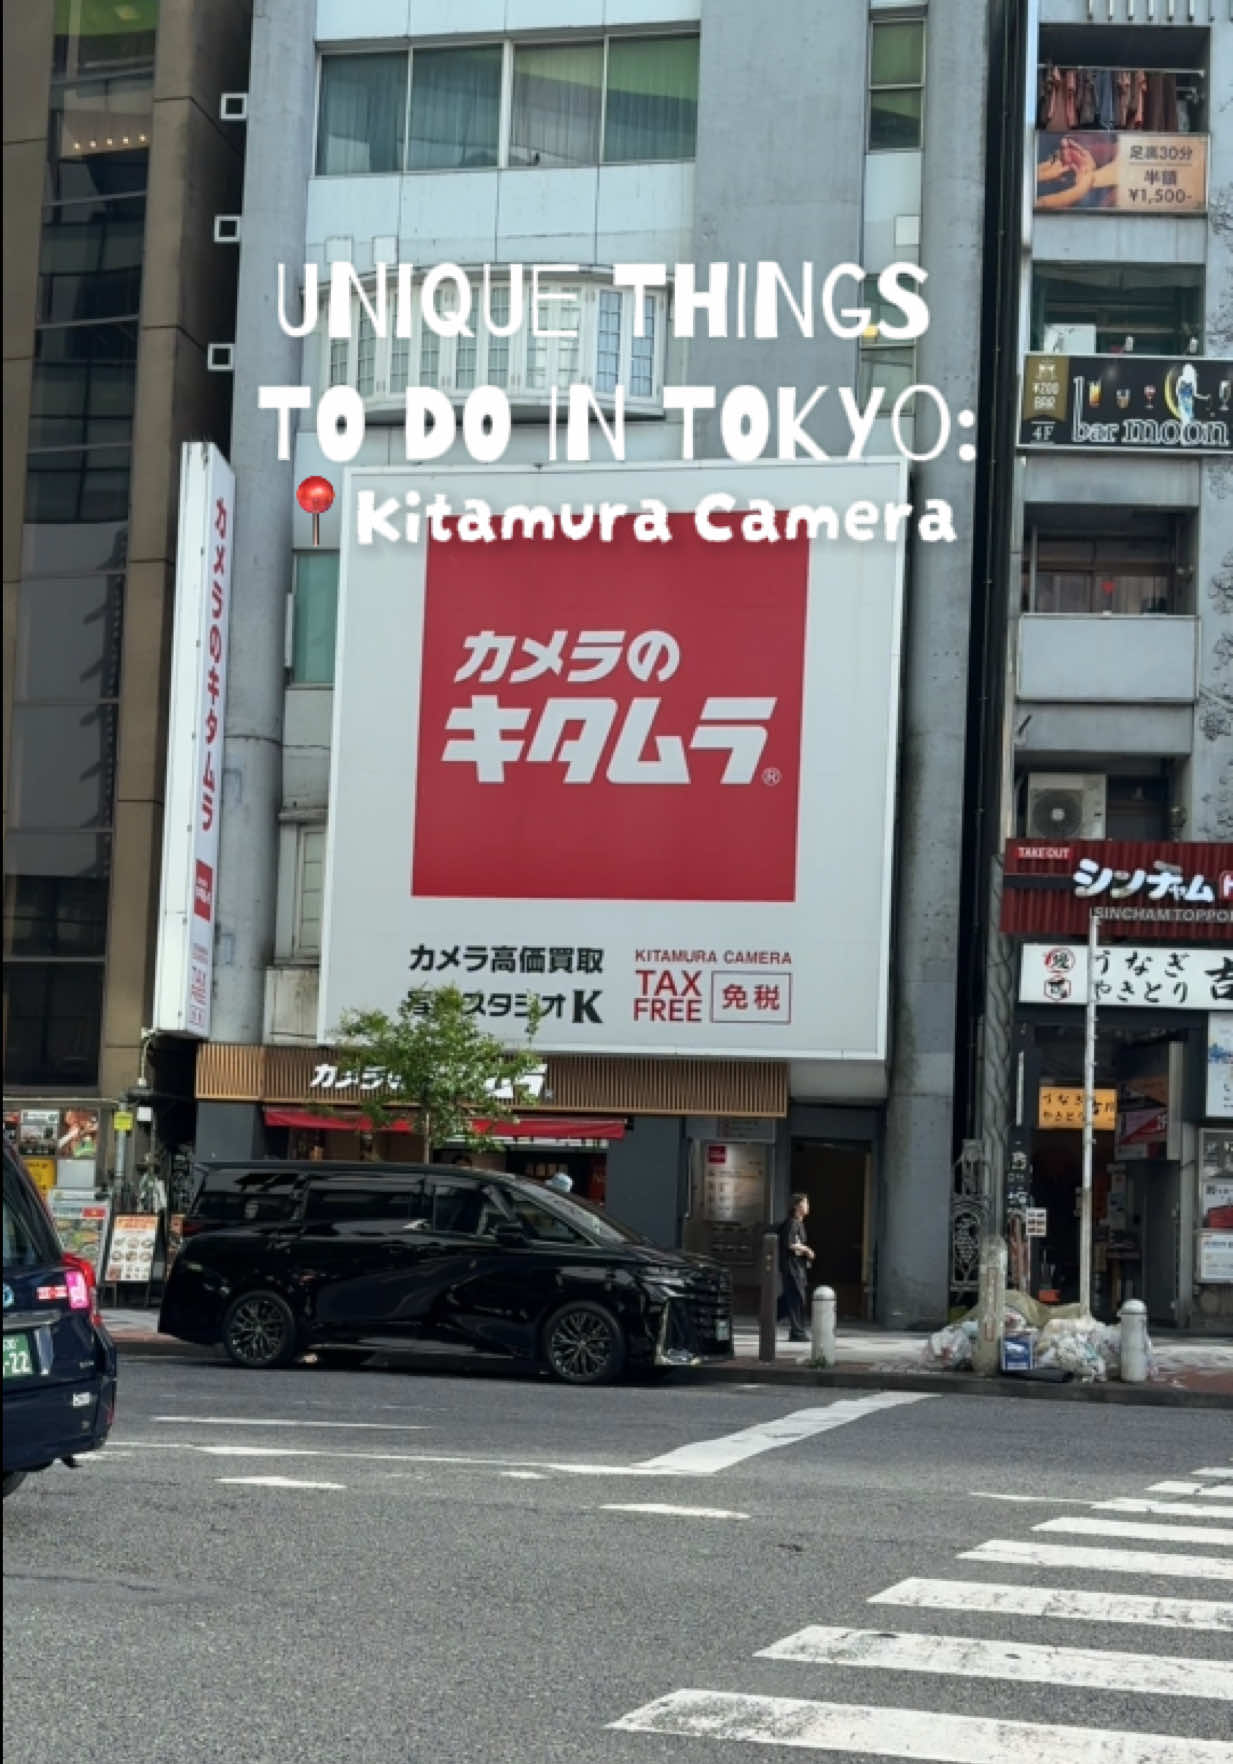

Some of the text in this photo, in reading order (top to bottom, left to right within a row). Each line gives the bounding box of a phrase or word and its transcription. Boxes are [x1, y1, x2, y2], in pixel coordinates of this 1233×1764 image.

[1121, 418, 1230, 446] moon
[453, 629, 681, 684] カメラの
[1047, 847, 1070, 860] OUT
[408, 943, 604, 974] カメラ高価買取
[634, 949, 792, 965] KITAMURA CAMERA
[1095, 950, 1190, 979] うなぎ
[635, 969, 702, 997] TAX
[721, 983, 781, 1011] 免税
[1094, 981, 1189, 1004] やきとり
[633, 998, 702, 1023] FREE
